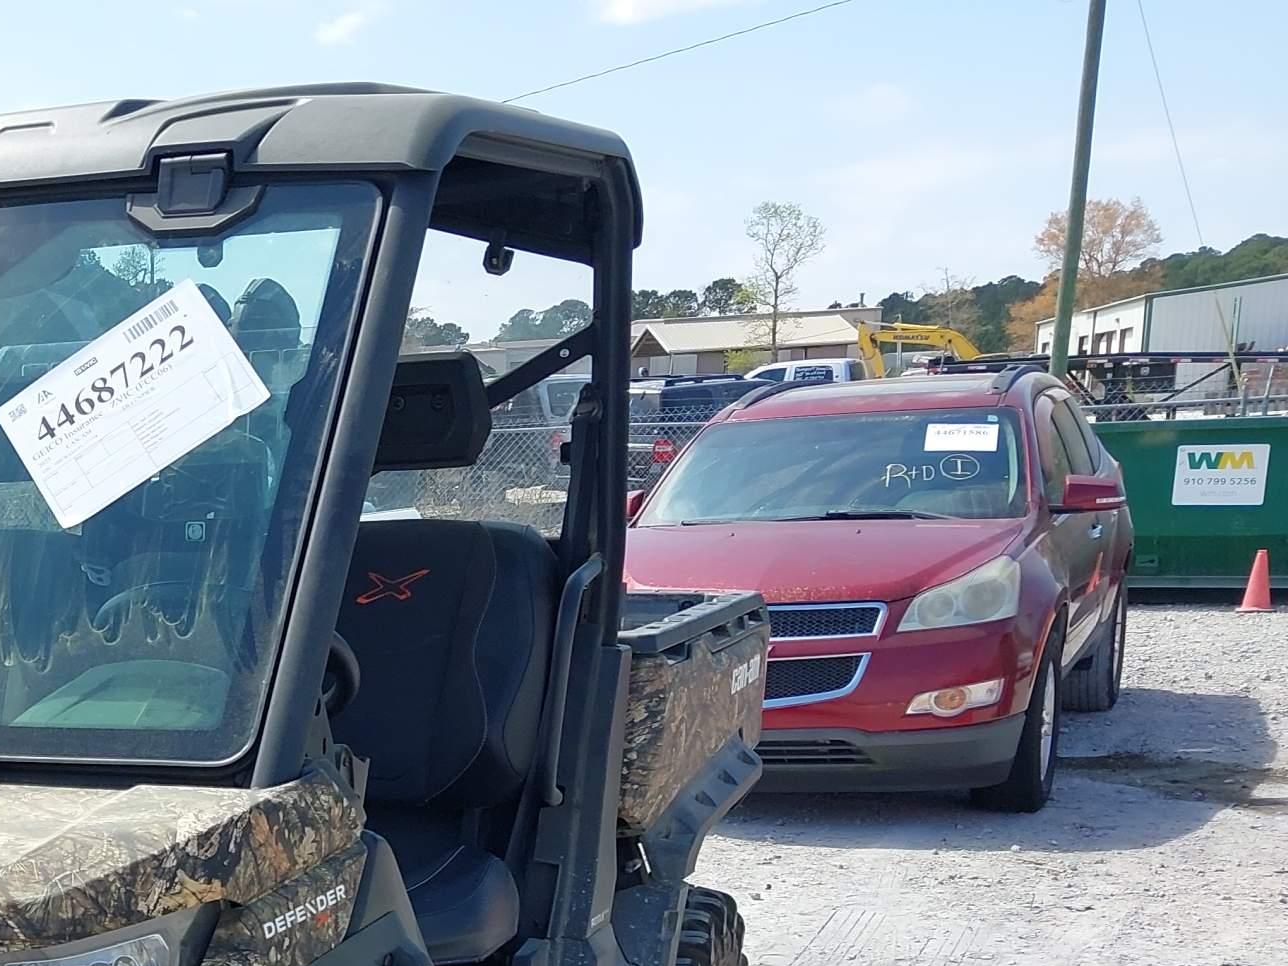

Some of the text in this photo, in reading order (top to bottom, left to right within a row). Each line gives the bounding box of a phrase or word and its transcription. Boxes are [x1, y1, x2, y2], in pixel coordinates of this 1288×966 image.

[38, 325, 194, 440] 44687222
[32, 437, 63, 461] GEICO
[64, 413, 103, 439] Insurance
[1187, 451, 1255, 470] WM
[1183, 477, 1257, 486] 910 799 5256
[262, 884, 346, 940] DEFENDER
